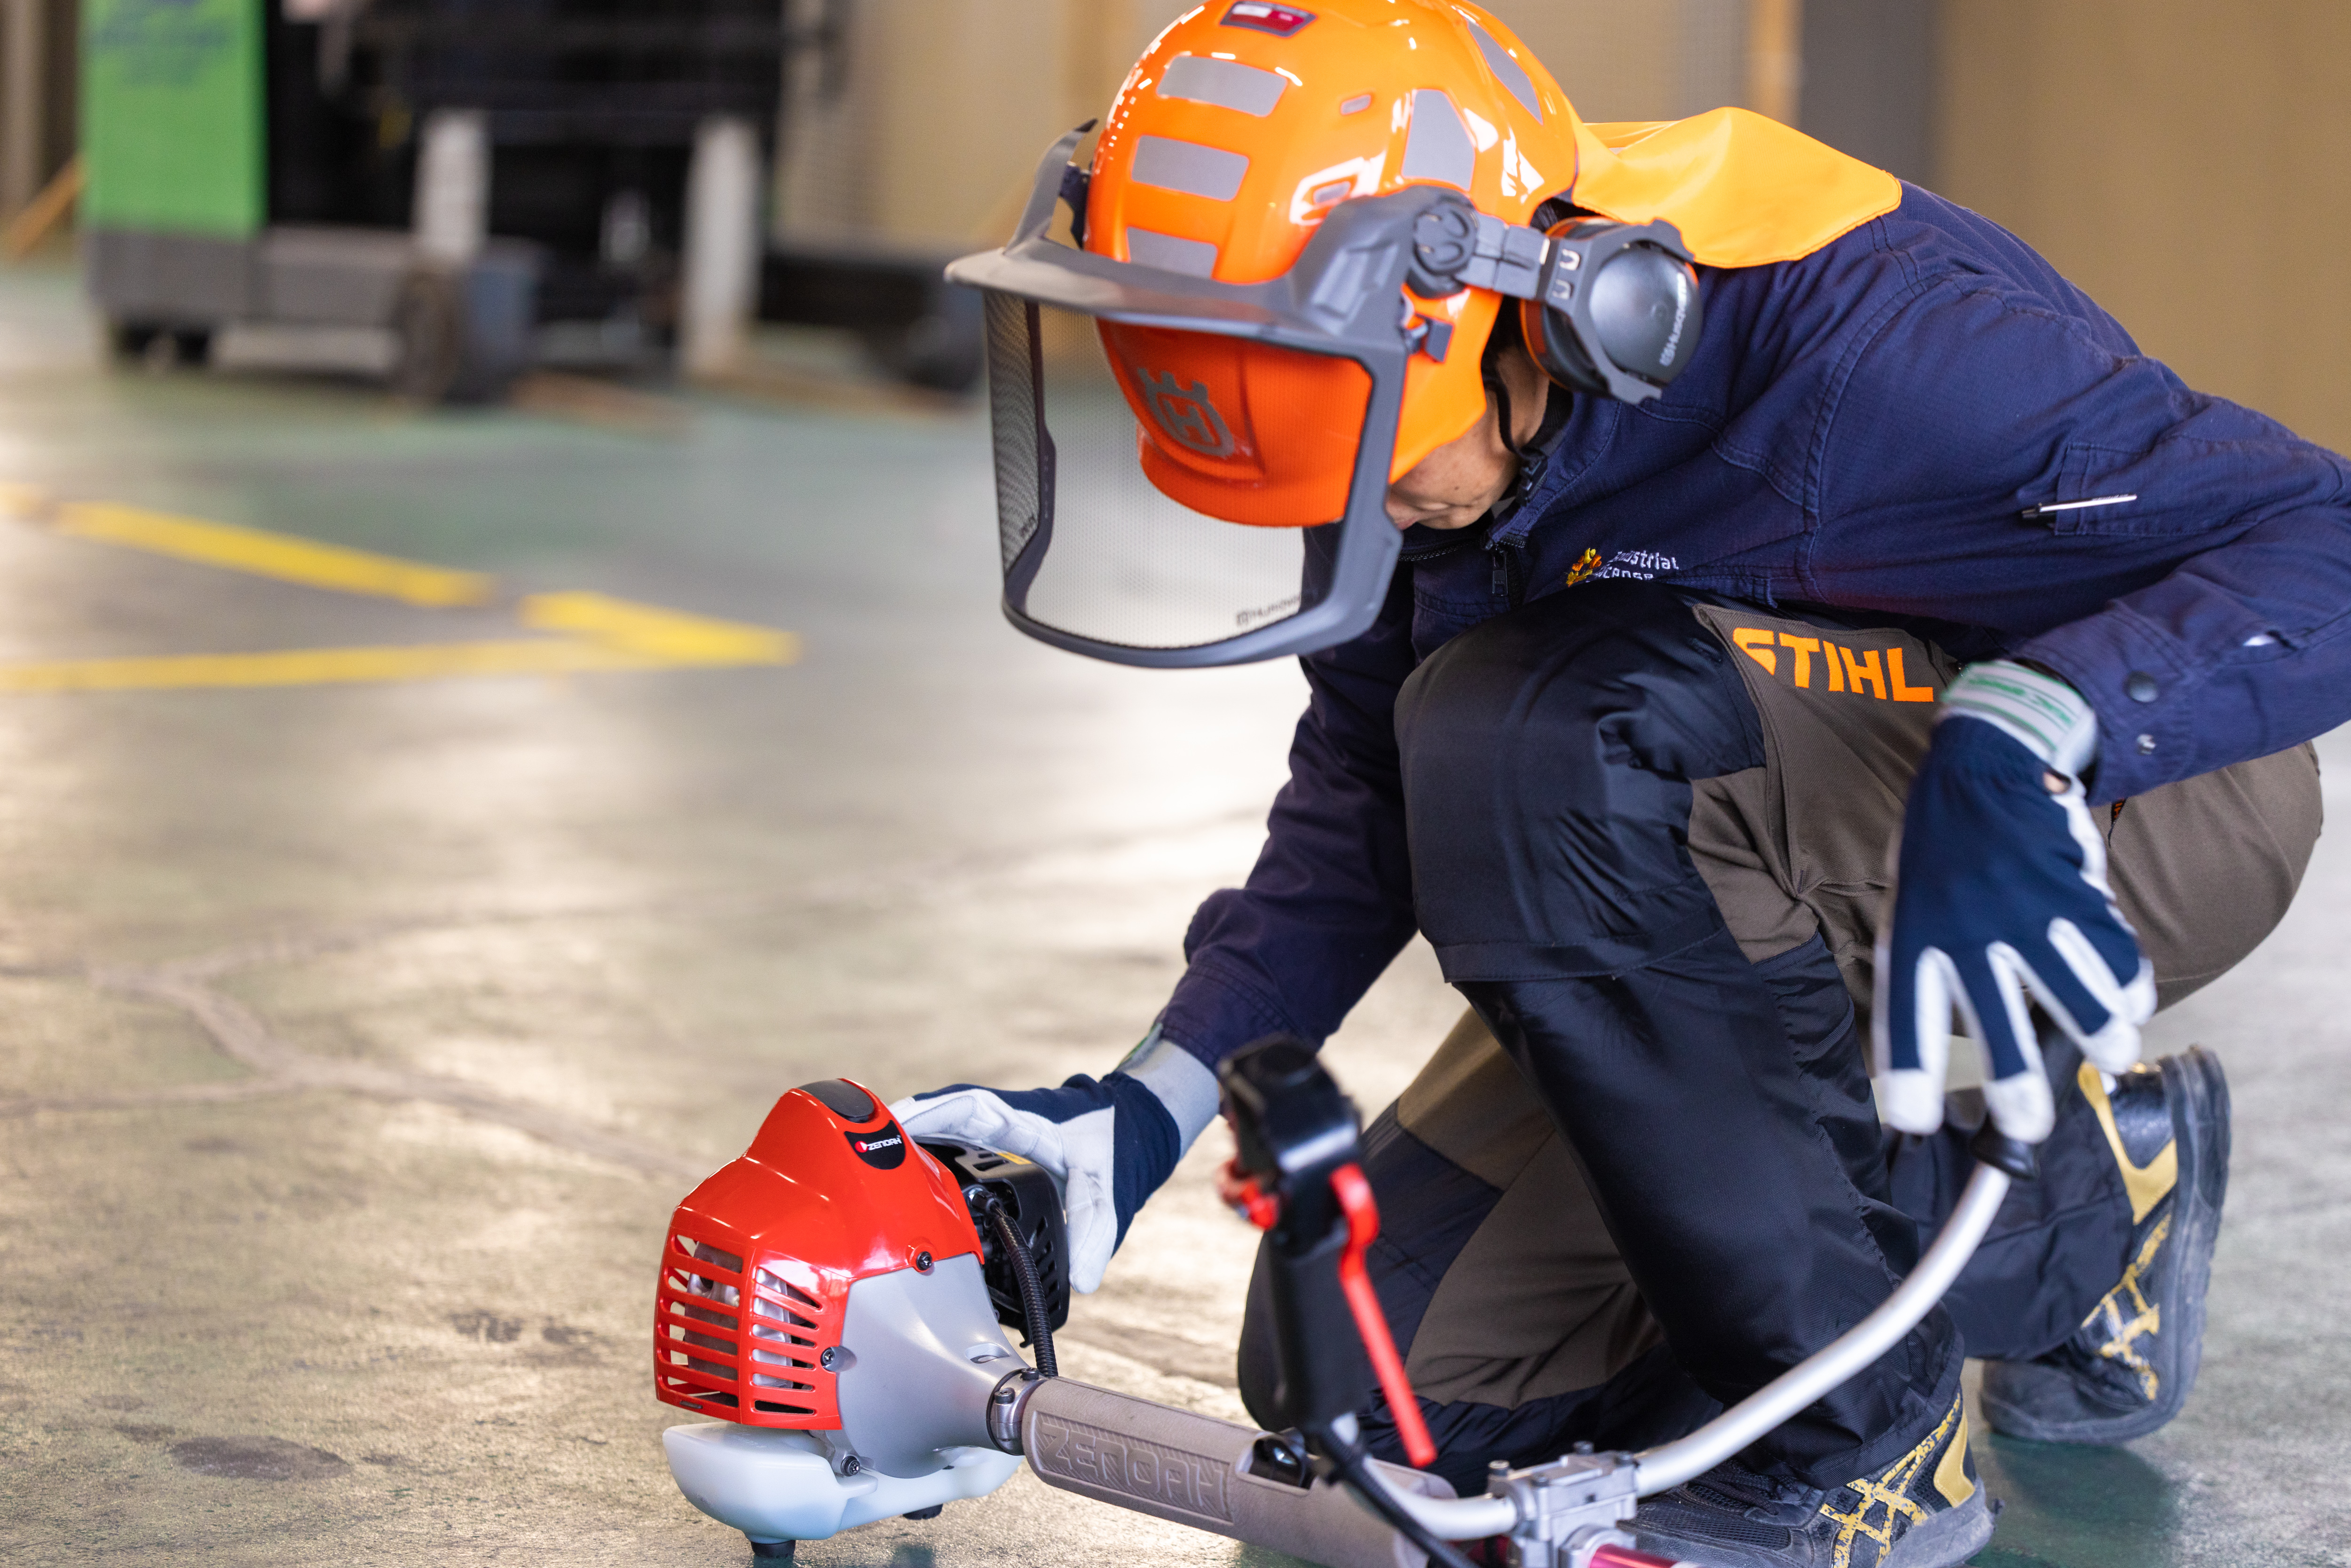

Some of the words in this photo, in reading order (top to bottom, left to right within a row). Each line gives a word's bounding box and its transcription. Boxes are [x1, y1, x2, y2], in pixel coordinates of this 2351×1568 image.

[1733, 628, 1934, 702] STIHL
[867, 1137, 902, 1150] ZENOAH
[1041, 1423, 1226, 1515] ZENOAH
